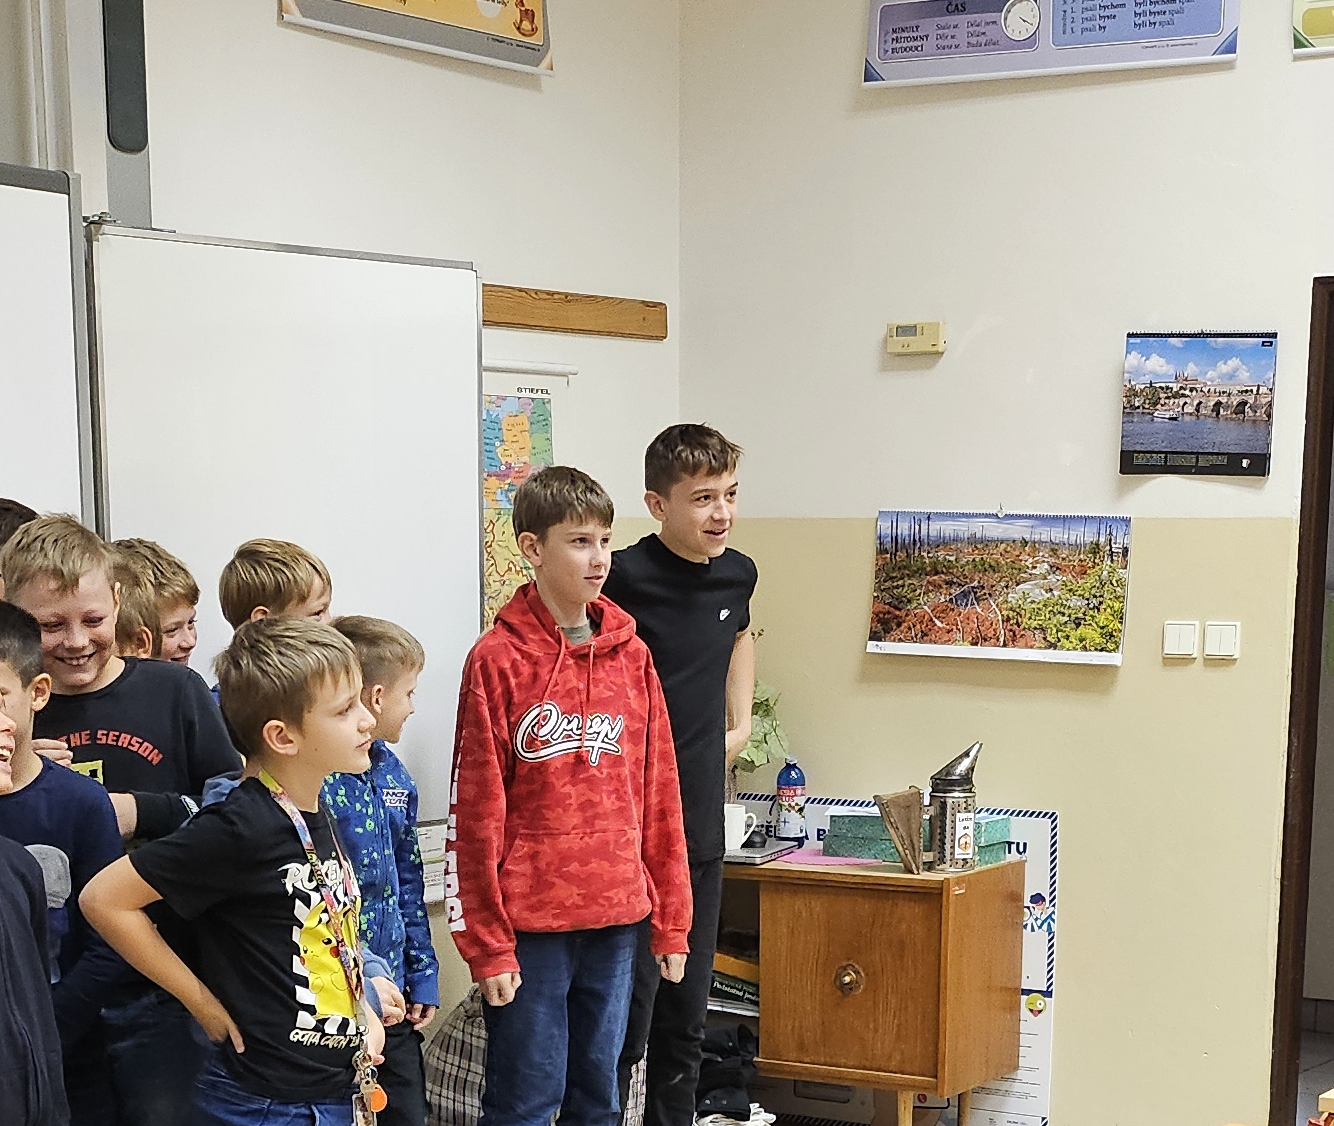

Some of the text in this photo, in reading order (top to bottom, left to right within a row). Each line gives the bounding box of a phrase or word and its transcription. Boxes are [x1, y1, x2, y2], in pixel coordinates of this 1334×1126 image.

[945, 0, 967, 14] ČAS
[890, 25, 921, 35] MINULÝ
[890, 43, 924, 55] BUDOUCÍ
[95, 729, 164, 766] SEASON
[289, 1028, 322, 1047] GOTTA
[320, 1035, 350, 1050] CATCH
